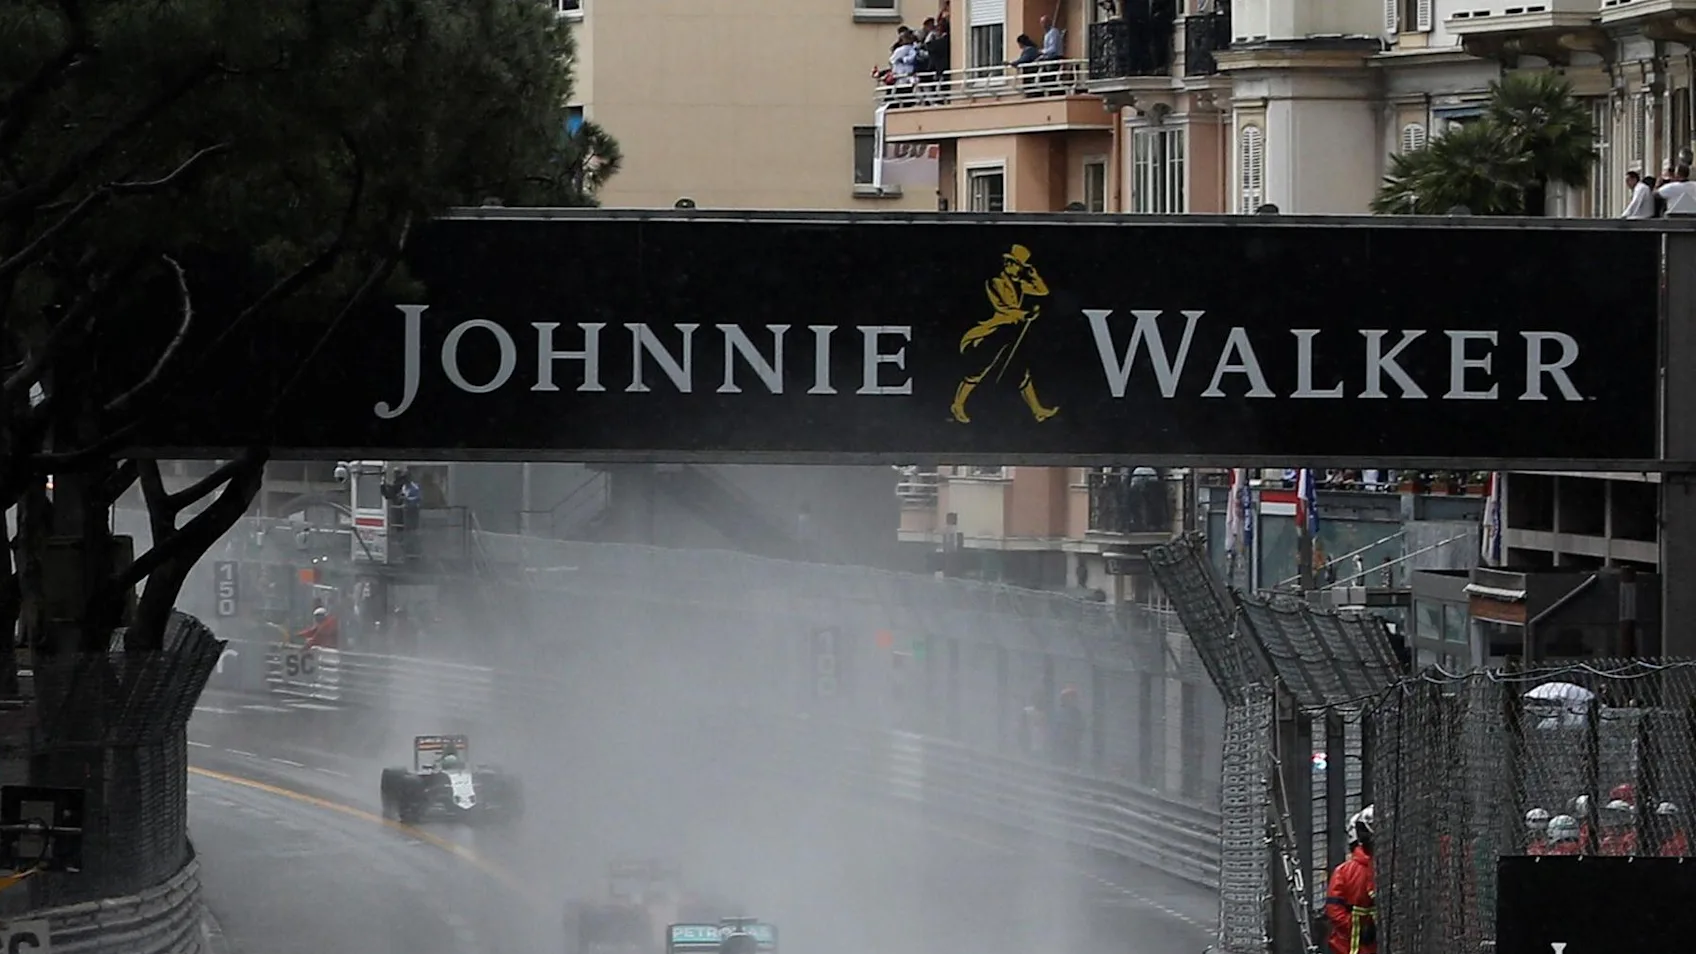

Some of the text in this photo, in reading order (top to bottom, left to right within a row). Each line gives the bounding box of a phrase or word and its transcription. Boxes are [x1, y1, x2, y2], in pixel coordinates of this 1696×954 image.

[374, 304, 1586, 420] JOHNNIE WALKER
[218, 563, 236, 616] 150
[285, 653, 315, 677] SC
[672, 926, 770, 938] PETROAS
